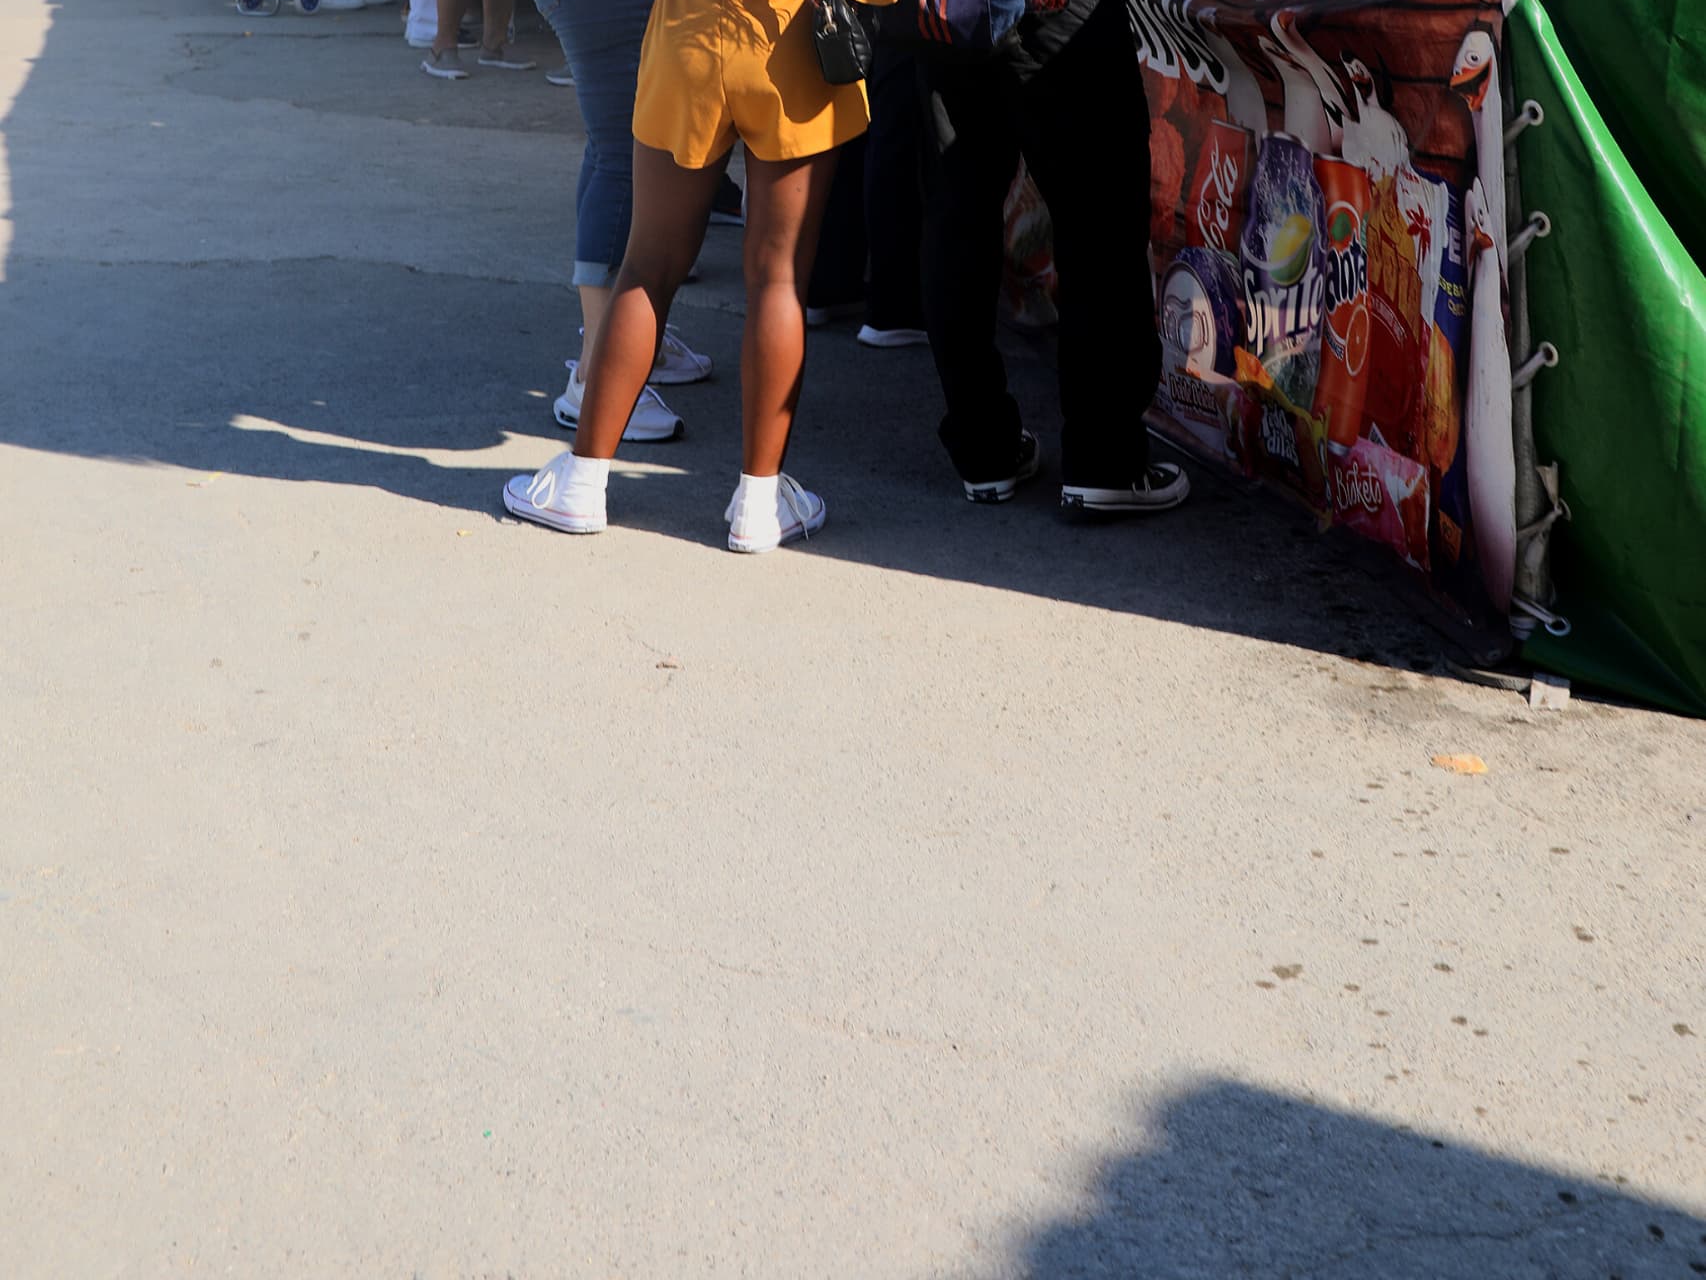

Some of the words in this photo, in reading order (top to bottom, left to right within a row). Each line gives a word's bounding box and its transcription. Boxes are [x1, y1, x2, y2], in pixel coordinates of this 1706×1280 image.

[1243, 251, 1324, 357] Sprite
[1325, 229, 1368, 314] anta
[1333, 461, 1382, 512] Biskets
